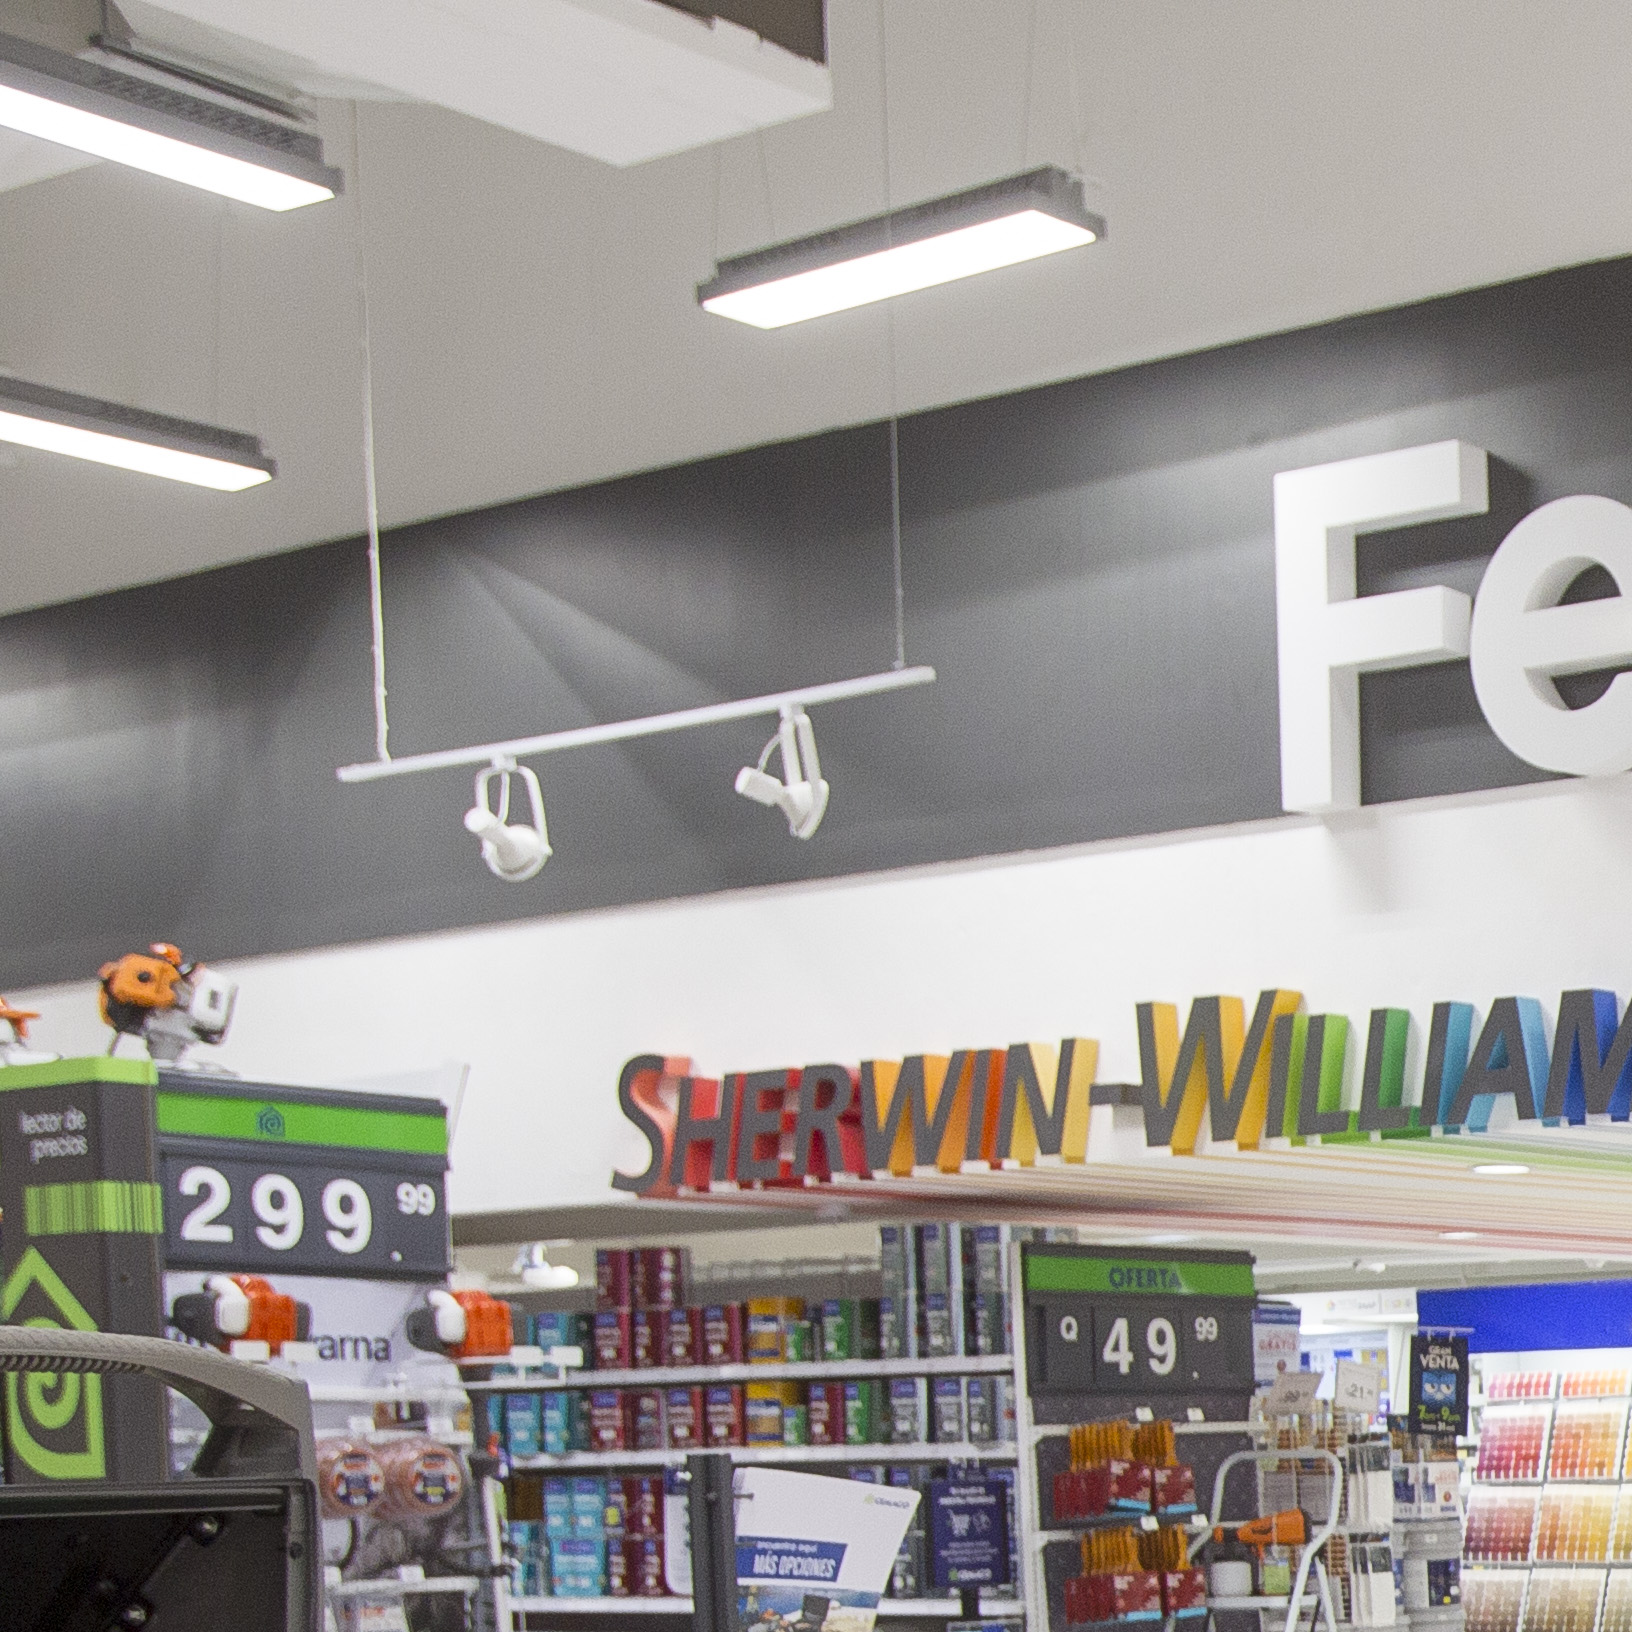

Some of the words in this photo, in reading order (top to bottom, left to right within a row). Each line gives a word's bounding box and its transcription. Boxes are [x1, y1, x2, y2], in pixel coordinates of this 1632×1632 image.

[18, 1110, 61, 1134] lector
[63, 1105, 87, 1130] de
[29, 1134, 88, 1165] precios
[1108, 1265, 1180, 1290] OFERTA
[1420, 1354, 1460, 1371] VENTA
[754, 1552, 777, 1575] MÁS
[778, 1556, 836, 1578] OPCIONES
